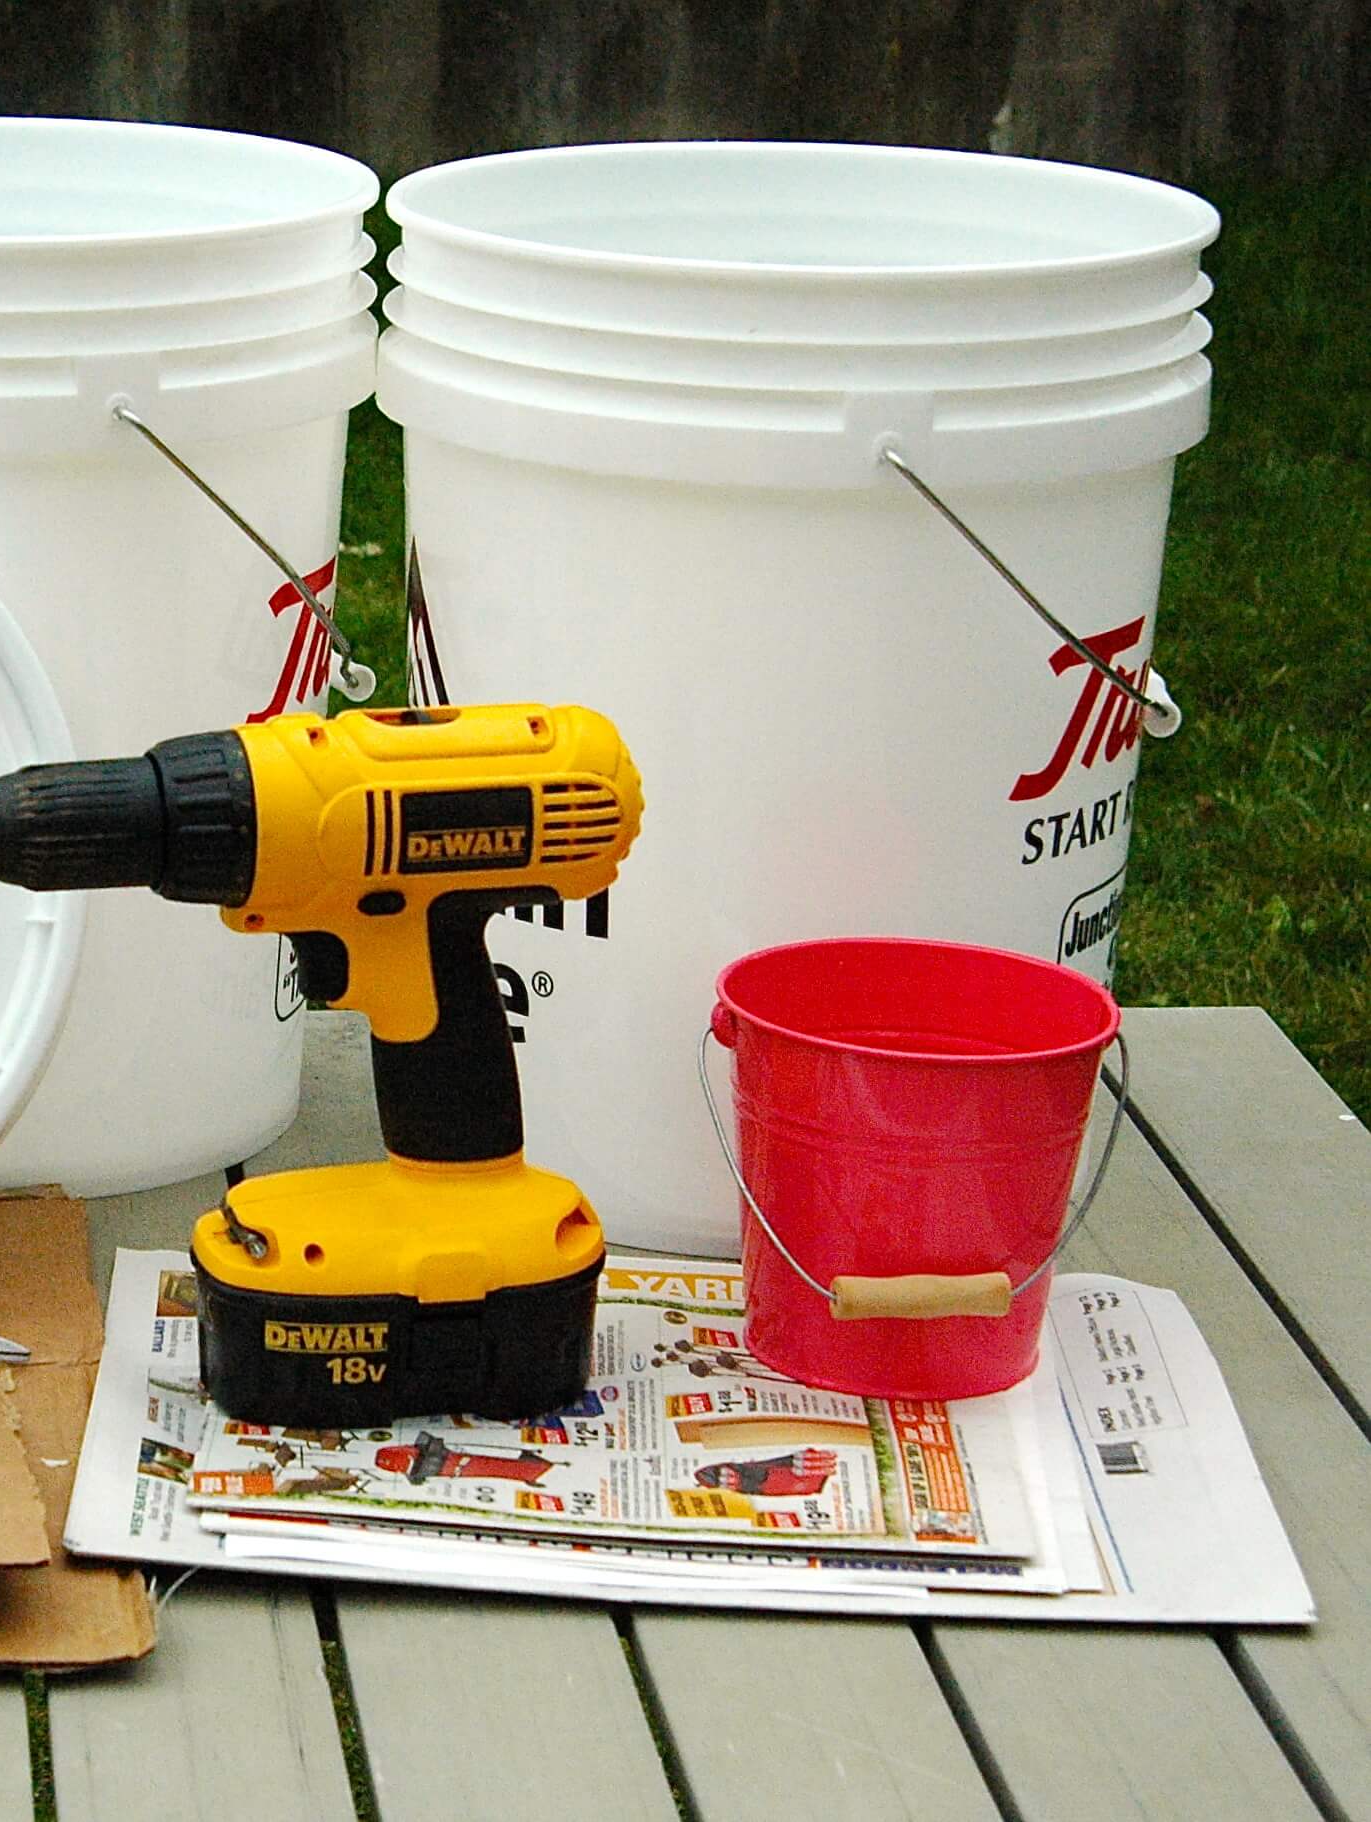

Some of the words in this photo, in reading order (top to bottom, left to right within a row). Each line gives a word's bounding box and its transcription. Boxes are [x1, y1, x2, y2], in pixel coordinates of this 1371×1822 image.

[1021, 790, 1122, 865] START
[407, 828, 526, 861] DEWALT
[265, 1320, 388, 1352] DEWALT
